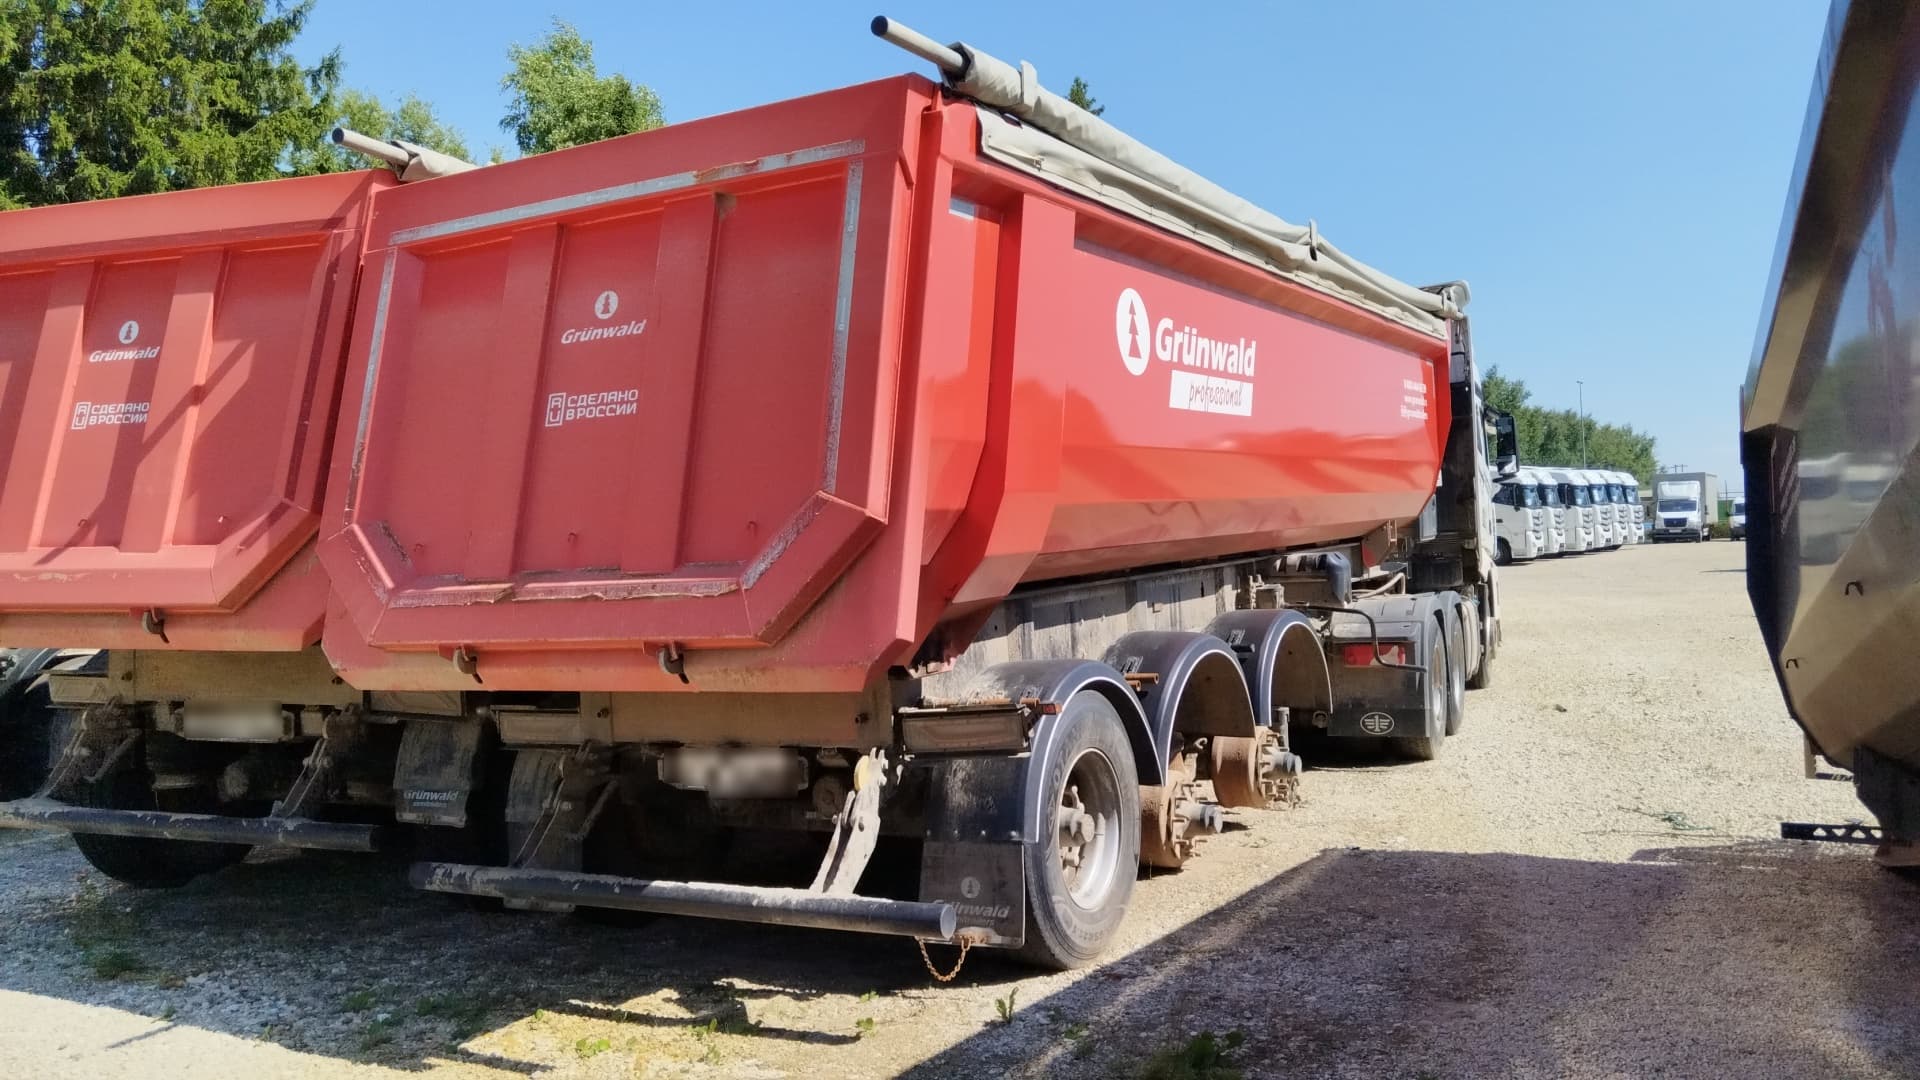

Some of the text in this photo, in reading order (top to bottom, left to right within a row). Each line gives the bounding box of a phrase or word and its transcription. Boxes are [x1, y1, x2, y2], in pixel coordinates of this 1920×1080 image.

[561, 319, 647, 344] Grünwald
[89, 346, 160, 362] Grünwald
[1155, 317, 1256, 377] Grünwald
[567, 389, 639, 407] СДЕЛАНО
[1188, 376, 1243, 412] professional
[91, 402, 150, 414] СДЕЛАНО
[403, 790, 459, 801] Grünwald
